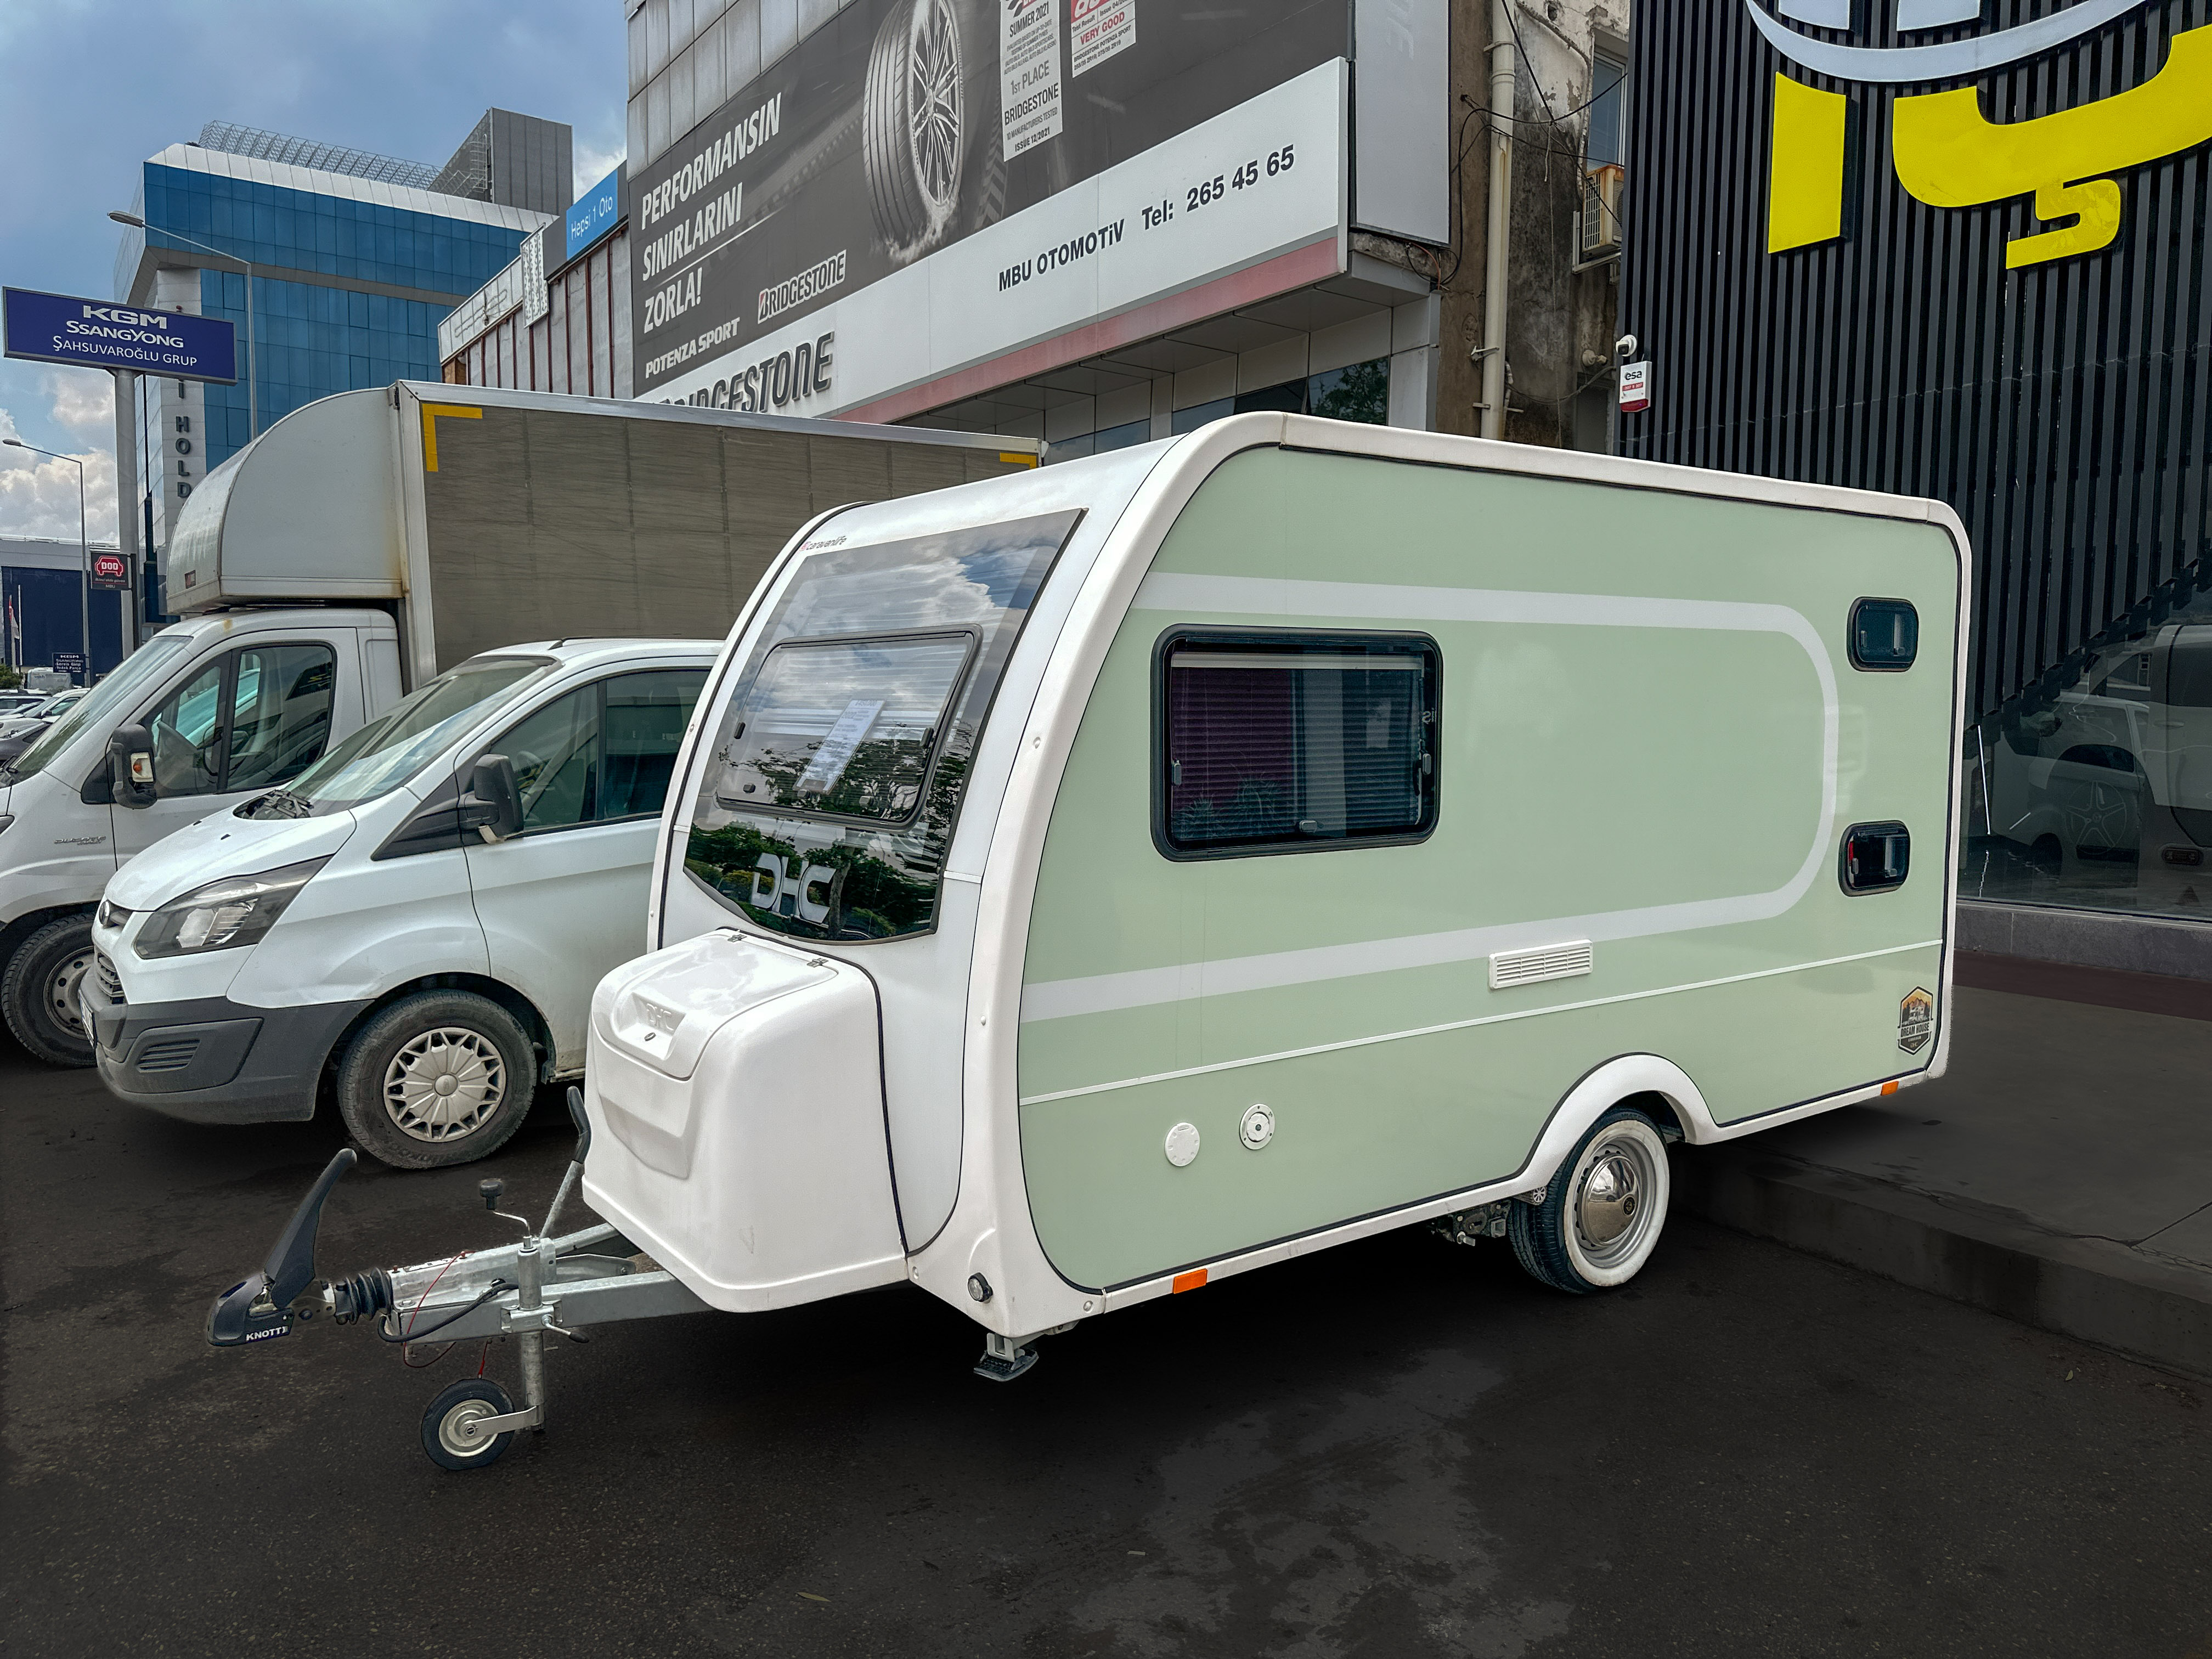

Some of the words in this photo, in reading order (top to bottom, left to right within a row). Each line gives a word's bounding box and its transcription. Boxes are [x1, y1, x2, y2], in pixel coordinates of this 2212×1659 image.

[1010, 11, 1035, 37] SUMMER
[1036, 1, 1048, 21] 2021
[1072, 24, 1081, 32] Test
[1081, 15, 1095, 27] Result
[1080, 25, 1100, 45] VERY
[1102, 12, 1125, 32] GOOD
[1074, 43, 1099, 63] BRIDGESTONE
[1100, 33, 1118, 48] POTENZA
[1118, 25, 1131, 37] SPORT
[1022, 60, 1049, 89] PLACE
[1005, 82, 1059, 126] BRIDGESTONE
[1011, 114, 1043, 138] MANUFACTURERS
[1043, 106, 1058, 121] TESTED
[1015, 137, 1030, 152] ISSUE
[1031, 127, 1050, 144] 12/2021
[642, 92, 781, 230] PERFORMANSIN
[571, 209, 591, 241] Hepsi
[592, 205, 596, 222] 1
[599, 195, 613, 217] Oto
[642, 182, 742, 281] SINIRLARINI
[999, 259, 1031, 292] MBU
[1142, 199, 1173, 230] Tel:
[1187, 174, 1224, 212] 265
[1232, 160, 1259, 190] 45
[1266, 144, 1294, 177] 65
[644, 267, 702, 334] ZORLA!
[758, 251, 846, 323] BRIDGESTONE
[83, 305, 167, 329] KGM
[66, 320, 184, 348] SSANGYONG
[646, 339, 697, 379] POTENZA
[698, 317, 740, 353] SPORT
[53, 336, 159, 362] ŞAHSUVAROĞLU
[162, 354, 197, 366] GRUP
[1625, 371, 1642, 380] esa
[101, 562, 119, 571] DOD
[751, 853, 837, 923] DHC
[1901, 1025, 1915, 1037] DREAM
[1916, 1022, 1929, 1034] HOUSE
[246, 1327, 282, 1341] KNOTT
